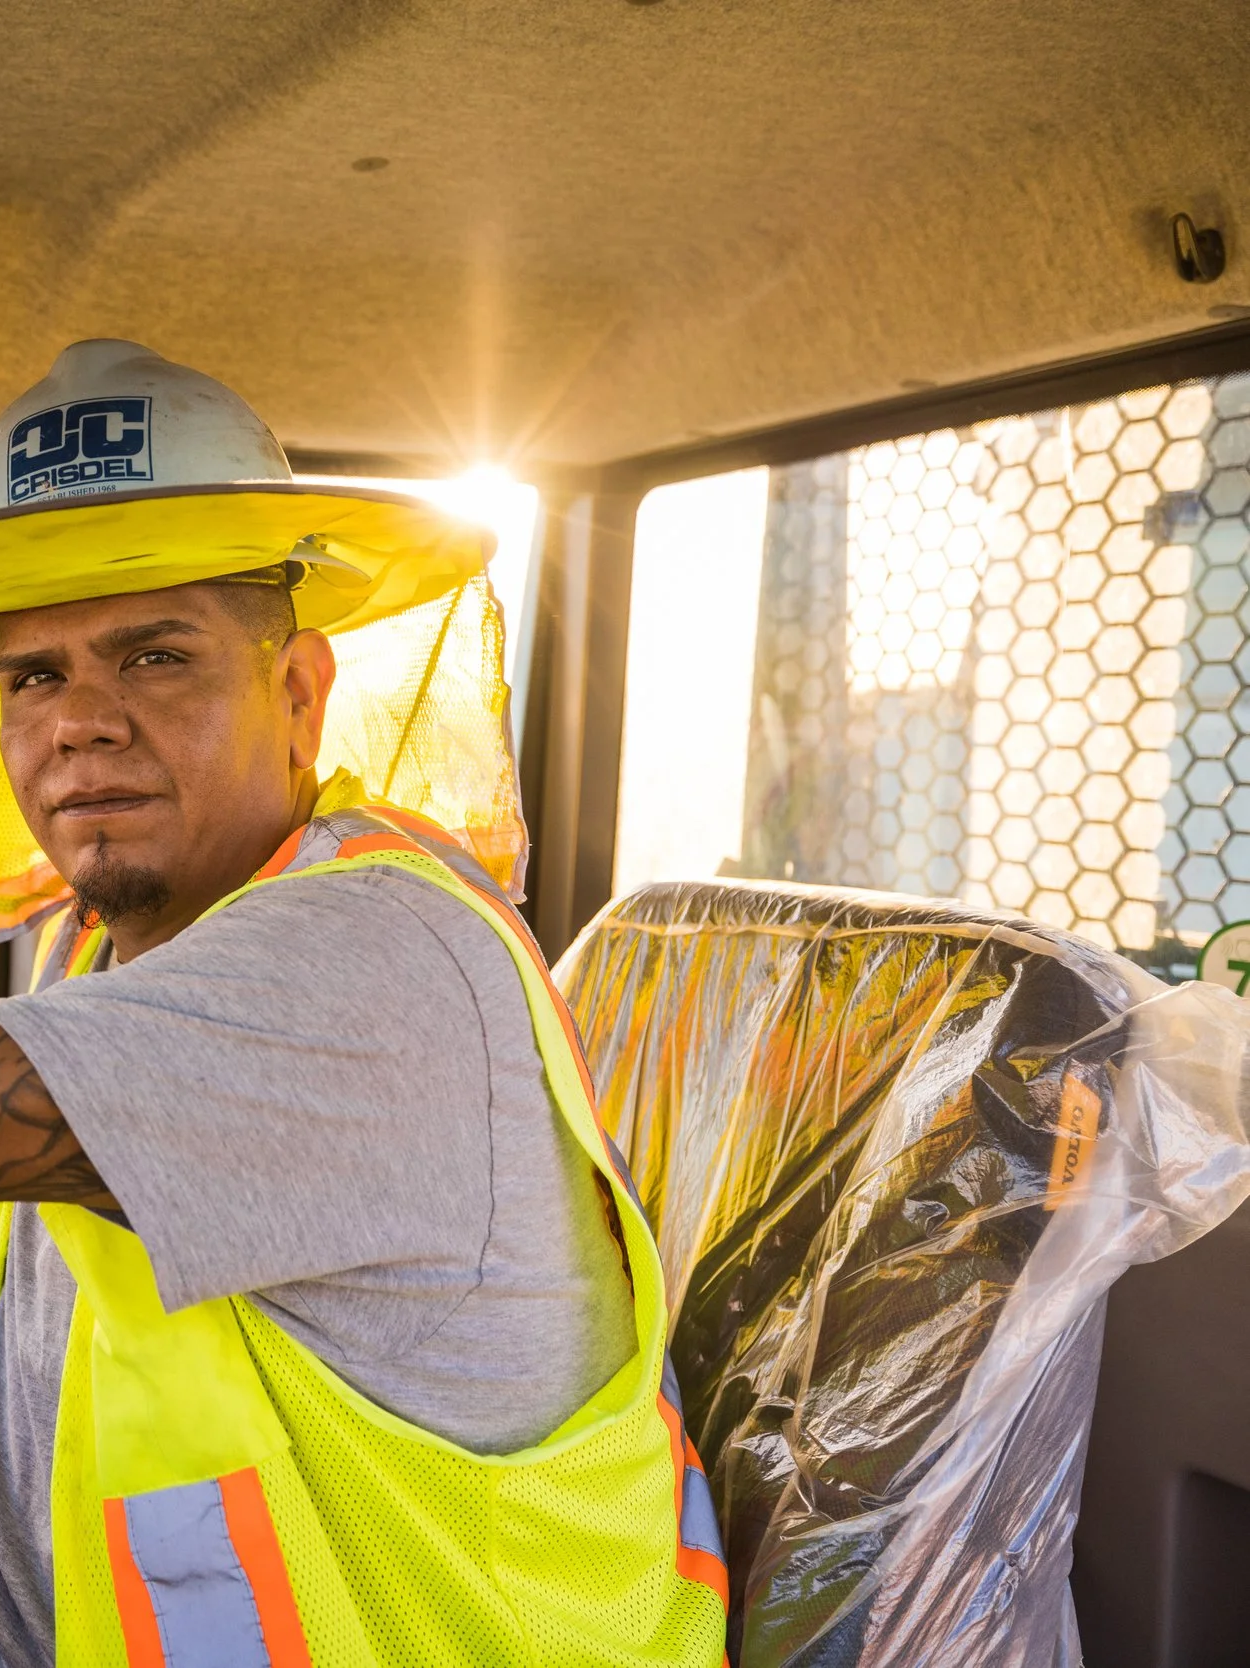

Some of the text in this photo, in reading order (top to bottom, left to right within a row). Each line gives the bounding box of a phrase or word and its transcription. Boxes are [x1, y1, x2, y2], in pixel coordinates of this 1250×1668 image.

[11, 458, 146, 501] CRISDEL
[97, 484, 117, 493] 1968
[1061, 1105, 1084, 1185] VOLVO
